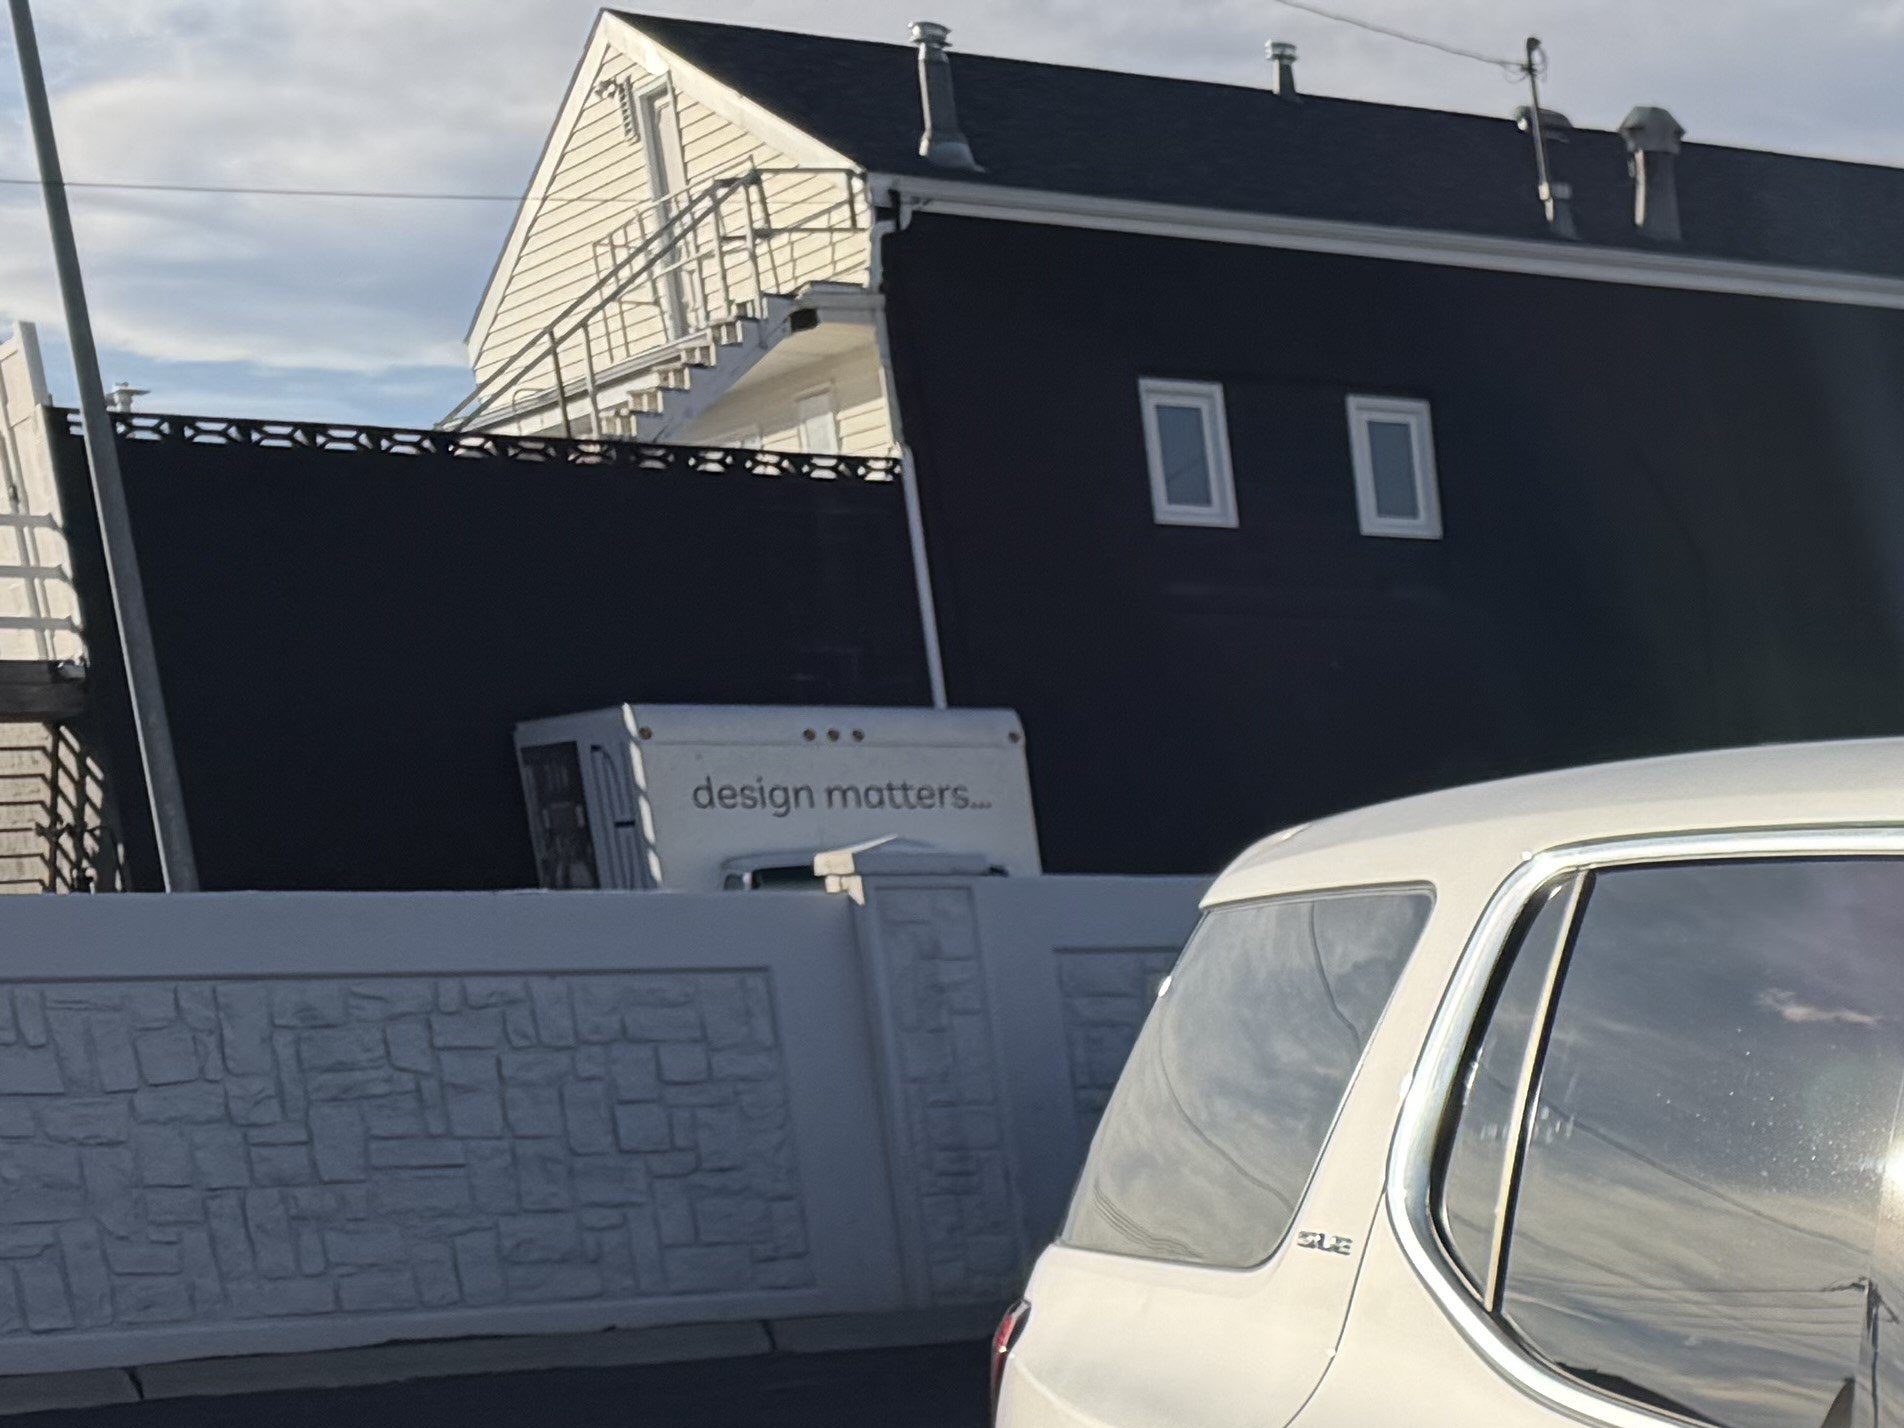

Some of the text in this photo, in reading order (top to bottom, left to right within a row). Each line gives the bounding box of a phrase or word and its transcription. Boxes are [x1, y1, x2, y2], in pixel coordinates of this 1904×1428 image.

[692, 775, 993, 818] design matters...
[1297, 1230, 1353, 1256] SLE
